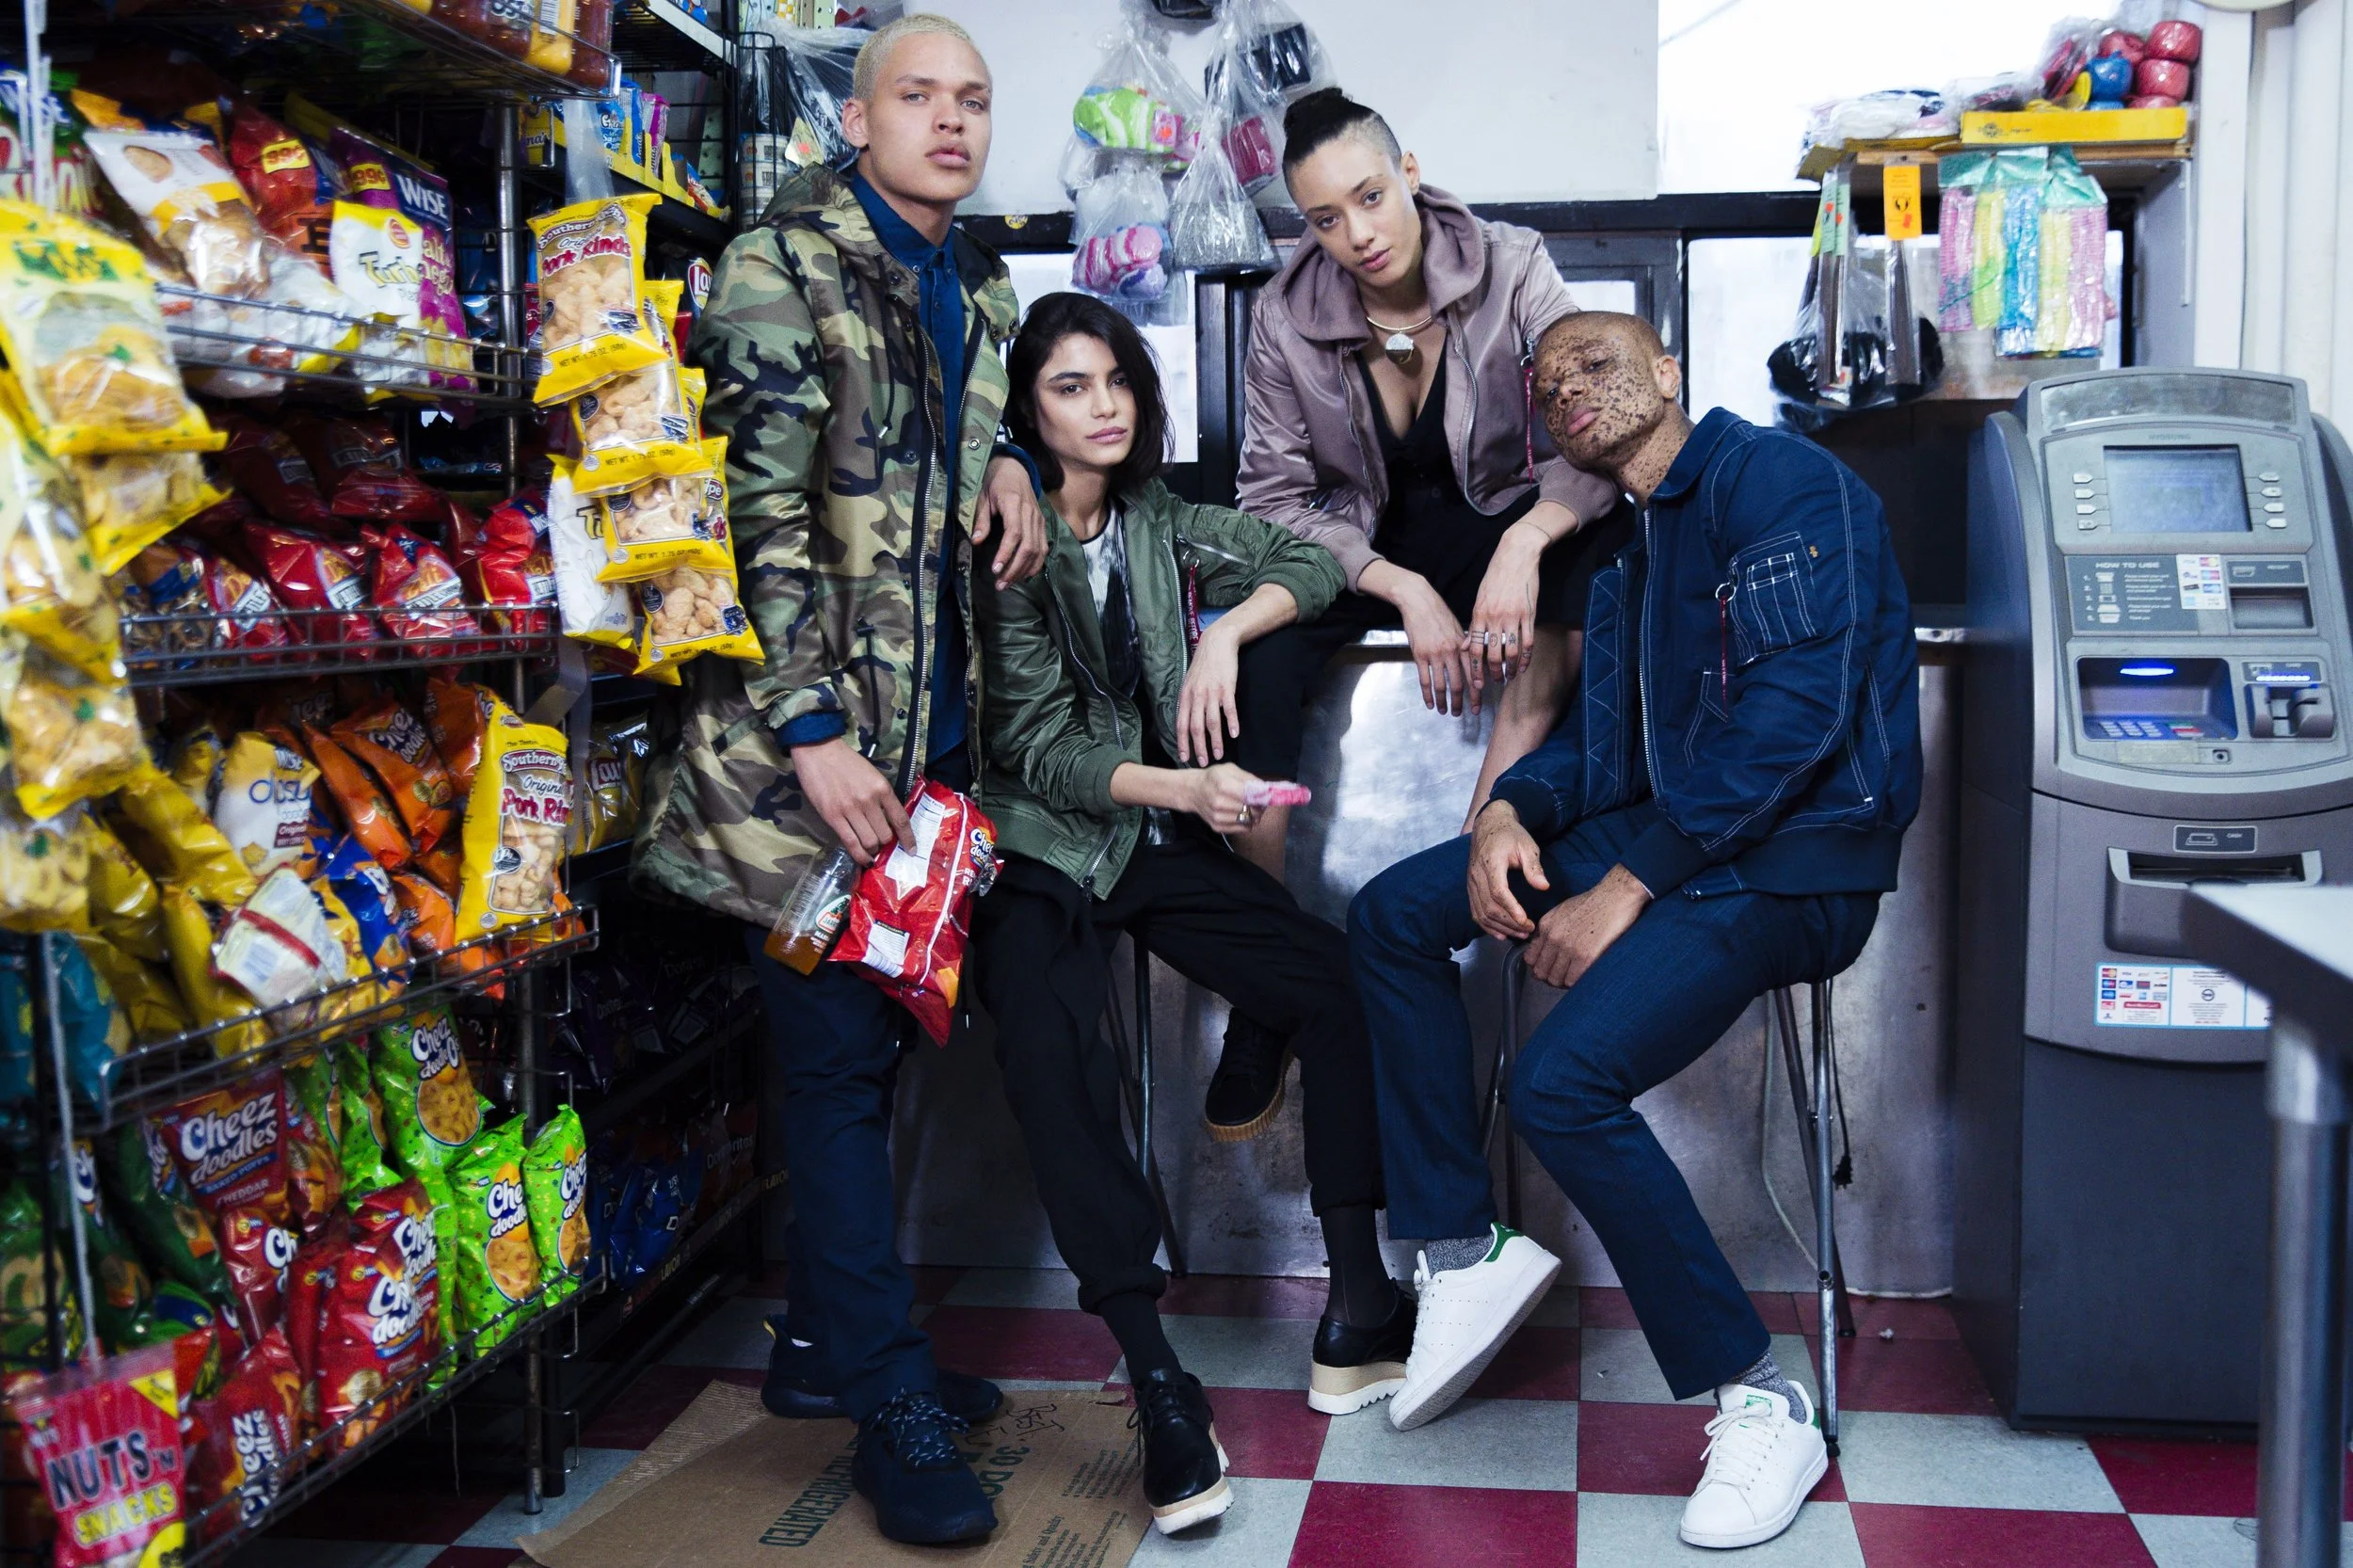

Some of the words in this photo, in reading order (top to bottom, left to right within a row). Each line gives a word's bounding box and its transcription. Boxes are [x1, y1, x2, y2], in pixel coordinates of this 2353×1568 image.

[395, 173, 448, 219] WISE
[423, 237, 446, 265] alt
[538, 218, 595, 250] Southern
[559, 357, 571, 368] NET
[606, 456, 617, 467] NET
[670, 649, 682, 658] NET
[502, 752, 557, 773] Southern
[502, 788, 540, 820] Pork
[543, 797, 567, 824] Rin
[411, 1016, 452, 1063] Cheez
[182, 1092, 278, 1161] Cheez
[190, 1120, 279, 1185] doodles
[216, 1178, 270, 1208] CHEDDAR
[487, 1178, 524, 1220] Che
[50, 1431, 151, 1509] NUTS
[76, 1482, 177, 1545] SNACKS
